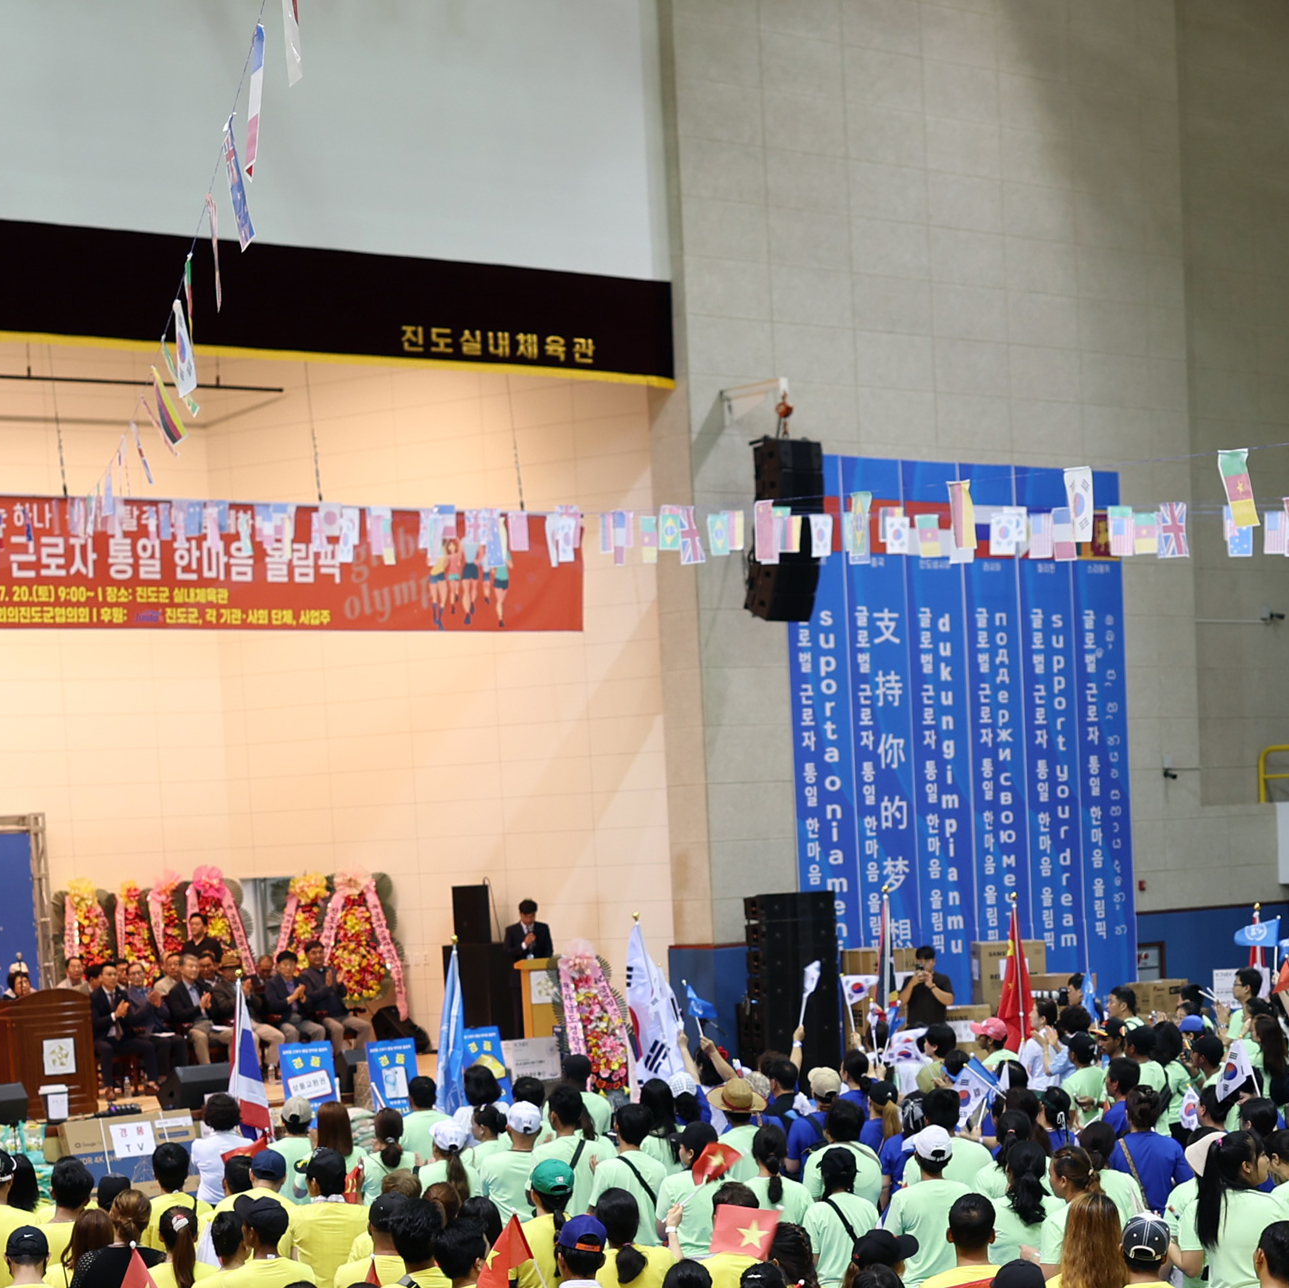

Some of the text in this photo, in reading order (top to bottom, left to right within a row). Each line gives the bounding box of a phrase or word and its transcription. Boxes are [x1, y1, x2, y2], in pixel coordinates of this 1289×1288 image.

[401, 325, 596, 364] 진도실내체육관
[10, 533, 97, 580] 근로자
[108, 537, 162, 580] 통일
[136, 587, 170, 603] 진도군
[938, 613, 955, 759] dukung
[975, 607, 990, 674] 글로벌
[797, 621, 822, 886] 로벌 근로자 통일 한마음
[855, 606, 880, 883] 글로벌 근로자 통일 한마음
[918, 607, 945, 954] 글로벌 근로자 통일 한마음 올림픽
[978, 683, 993, 748] 근로자
[981, 757, 994, 801] 통일
[995, 612, 1016, 843] поддержи свою
[1030, 608, 1055, 950] 글로벌 근로자 통일 한마음 올림픽
[1051, 614, 1077, 947] support your dream
[1083, 609, 1107, 939] 글로벌 근로자 통일 한마음 올림픽
[983, 810, 996, 875] 한마음
